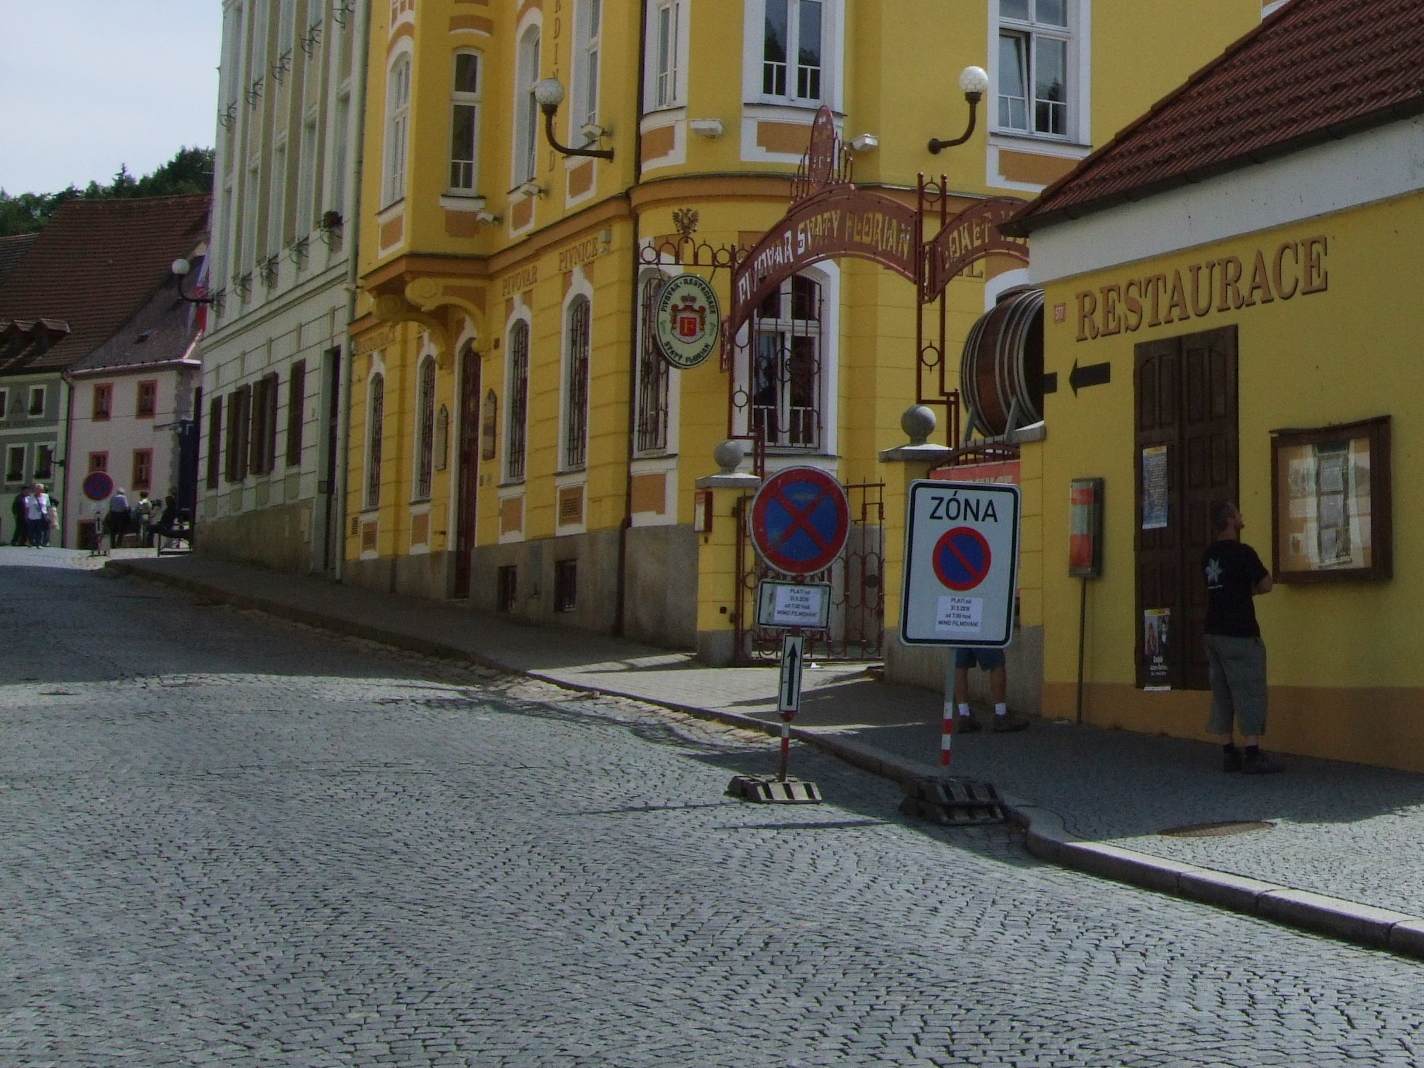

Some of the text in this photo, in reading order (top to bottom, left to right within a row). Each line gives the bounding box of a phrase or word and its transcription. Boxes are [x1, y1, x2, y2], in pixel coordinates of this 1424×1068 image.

[737, 230, 794, 308] PIVOVAR
[845, 209, 911, 261] FLORIAN
[501, 265, 538, 297] PIVOVAR
[1074, 234, 1330, 343] RESTAURACE
[660, 282, 682, 313] PIVOVAR
[684, 319, 695, 333] F
[929, 490, 999, 523] ZÓNA
